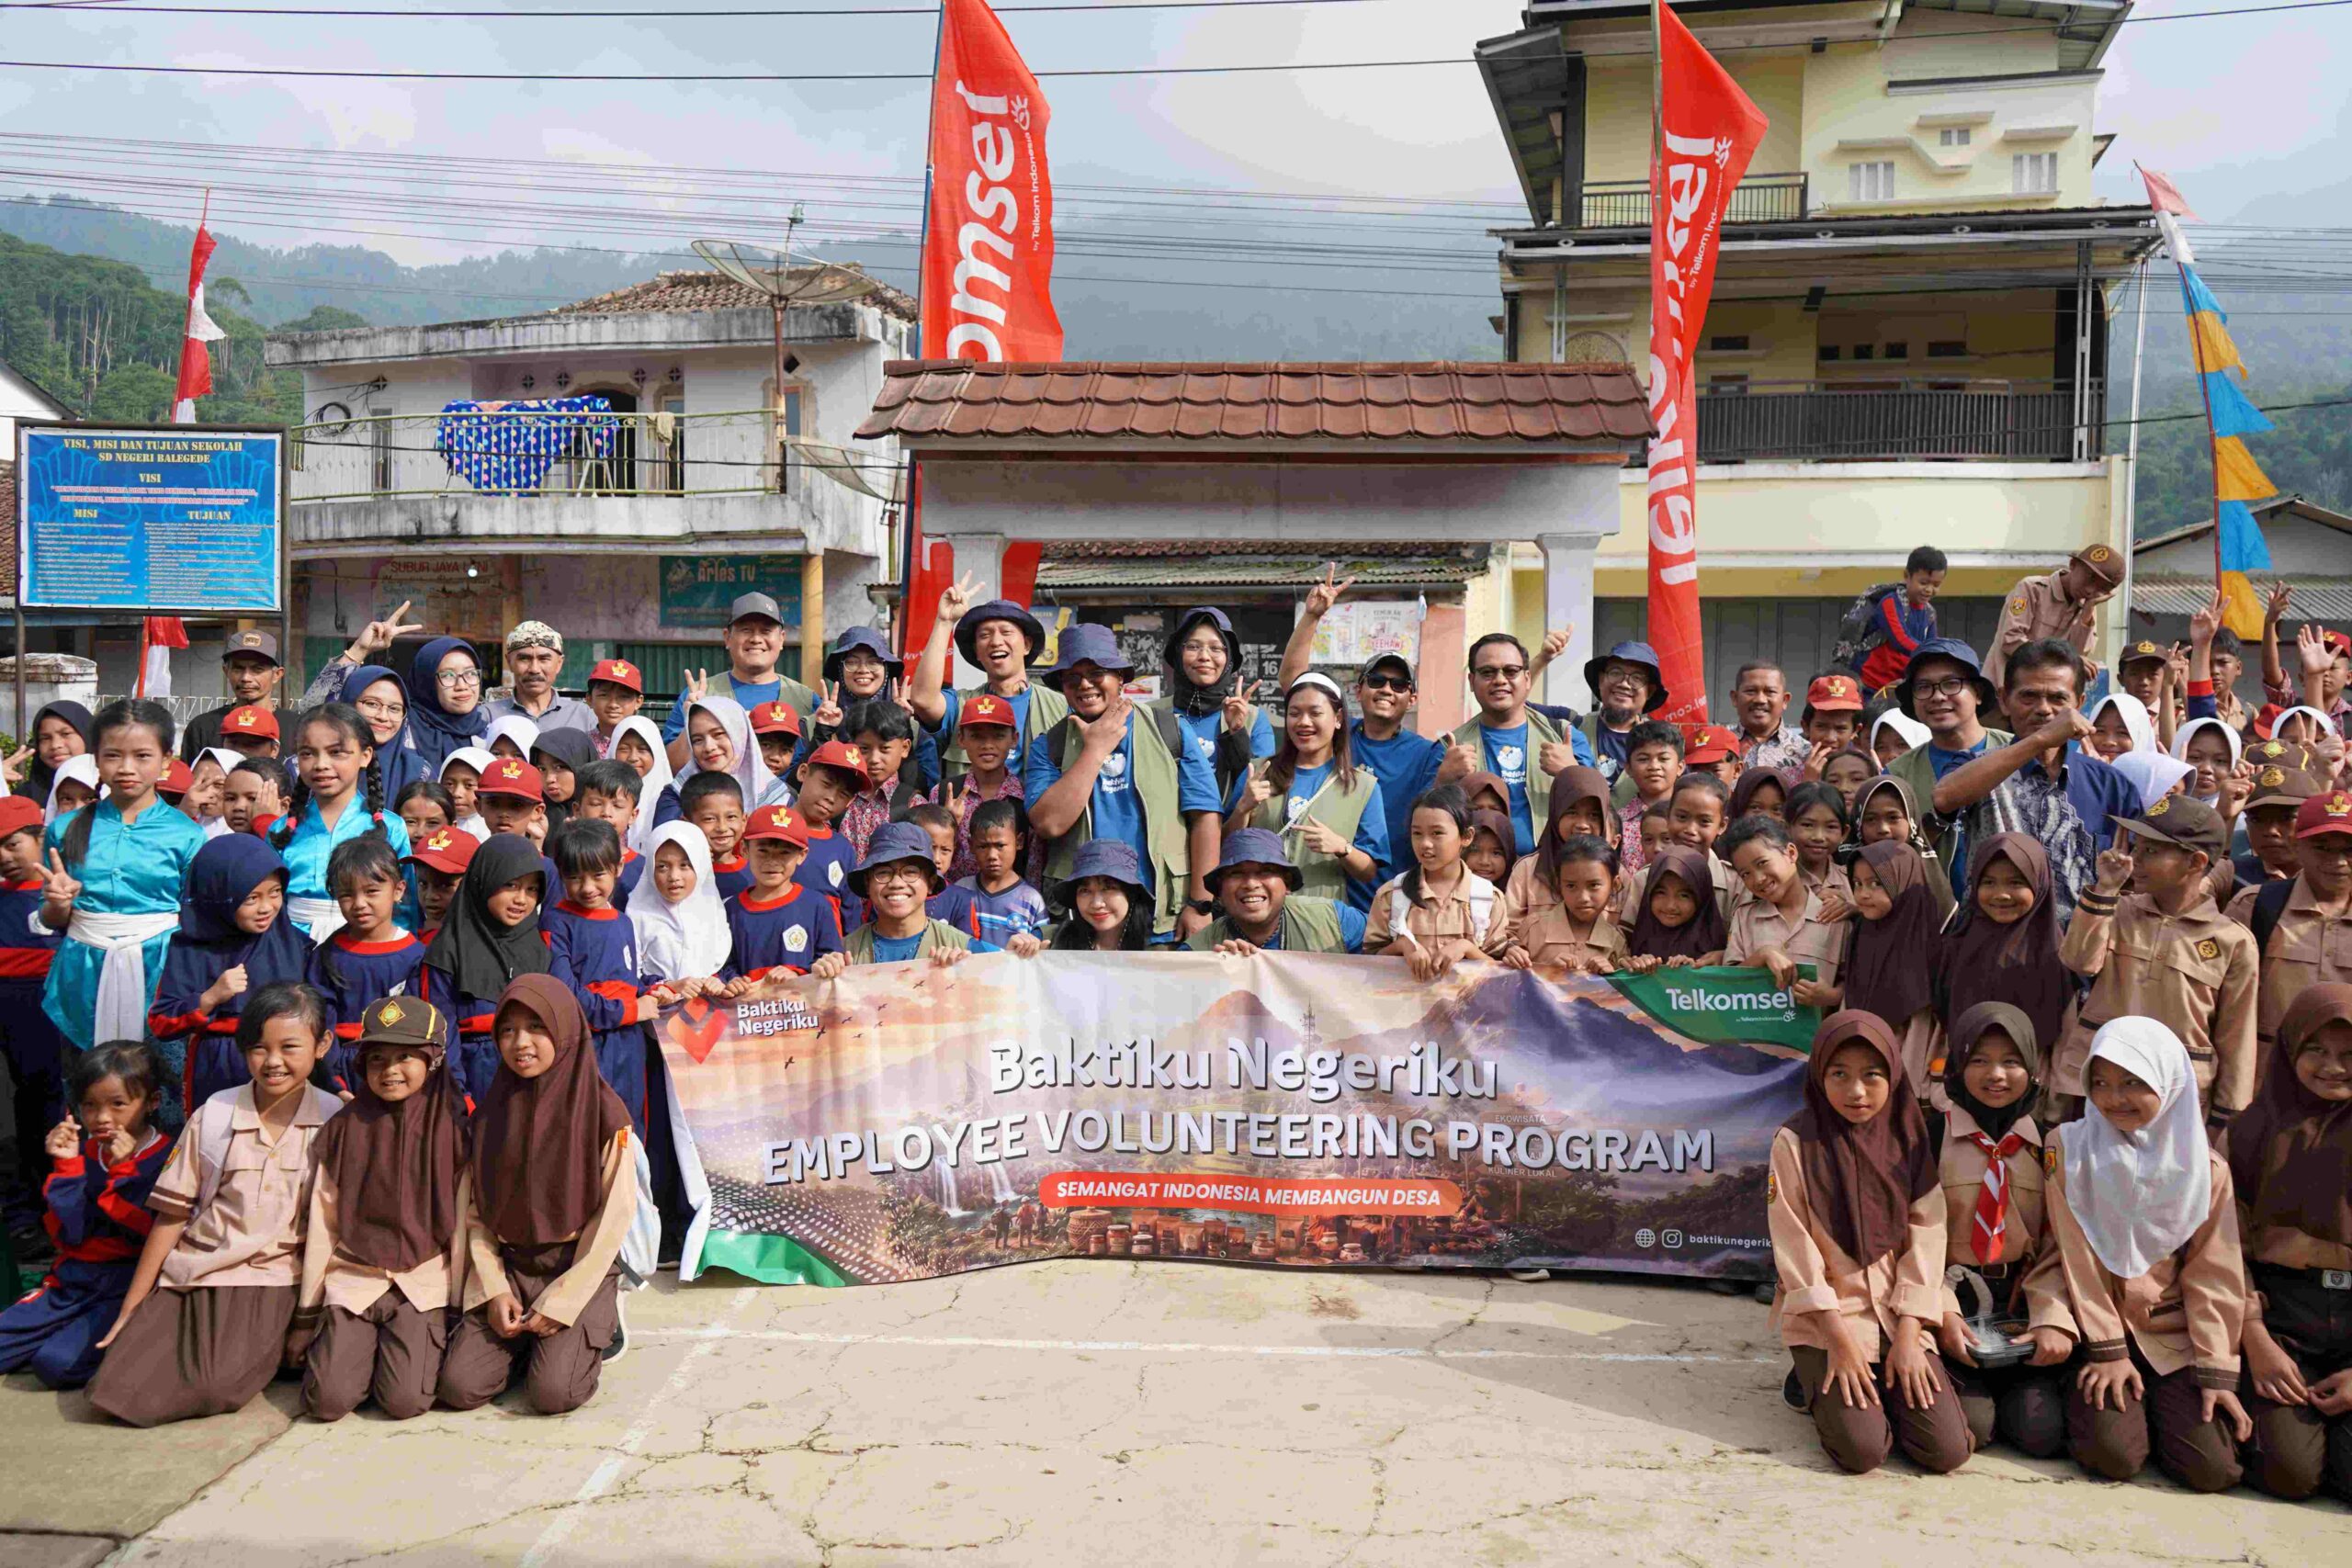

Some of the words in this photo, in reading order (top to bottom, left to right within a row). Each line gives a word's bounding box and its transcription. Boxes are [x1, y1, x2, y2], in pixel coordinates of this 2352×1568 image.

[1024, 132, 1040, 193] Indonesia
[946, 80, 1018, 362] omsel
[1032, 195, 1041, 240] Telkom
[1033, 241, 1040, 252] by
[1690, 233, 1711, 276] Telkom
[63, 439, 90, 449] VISI,
[93, 439, 118, 449] MISI
[121, 440, 142, 450] DAN
[146, 440, 188, 450] TUJUAN
[191, 441, 243, 451] SEKOLAH
[98, 452, 112, 462] SD
[116, 453, 153, 462] NEGERI
[157, 454, 210, 463] BALEGEDE
[139, 473, 162, 483] VISI
[74, 509, 98, 519] MISI
[187, 511, 231, 521] TUJUAN
[432, 561, 459, 572] JAYA
[740, 565, 756, 582] TV
[1262, 660, 1278, 675] 16
[1666, 987, 1795, 1010] Telkomsel
[737, 999, 806, 1018] Baktiku
[739, 1014, 819, 1036] Negeriku
[989, 1036, 1212, 1094] Baktiku
[1227, 1036, 1498, 1101] Negeriku
[1495, 1114, 1546, 1123] EKOWISATA
[762, 1113, 1028, 1185] EMPLOYEE
[1035, 1108, 1437, 1160] VOLUNTEERING
[1448, 1120, 1715, 1174] PROGRAM
[1488, 1167, 1526, 1176] KULINER
[1057, 1181, 1159, 1198] SEMANGAT
[1163, 1183, 1261, 1202] INDONESIA
[1265, 1189, 1389, 1205] MEMBANGUN
[1392, 1190, 1441, 1205] DESA
[1689, 1235, 1771, 1248] baktikunegerik
